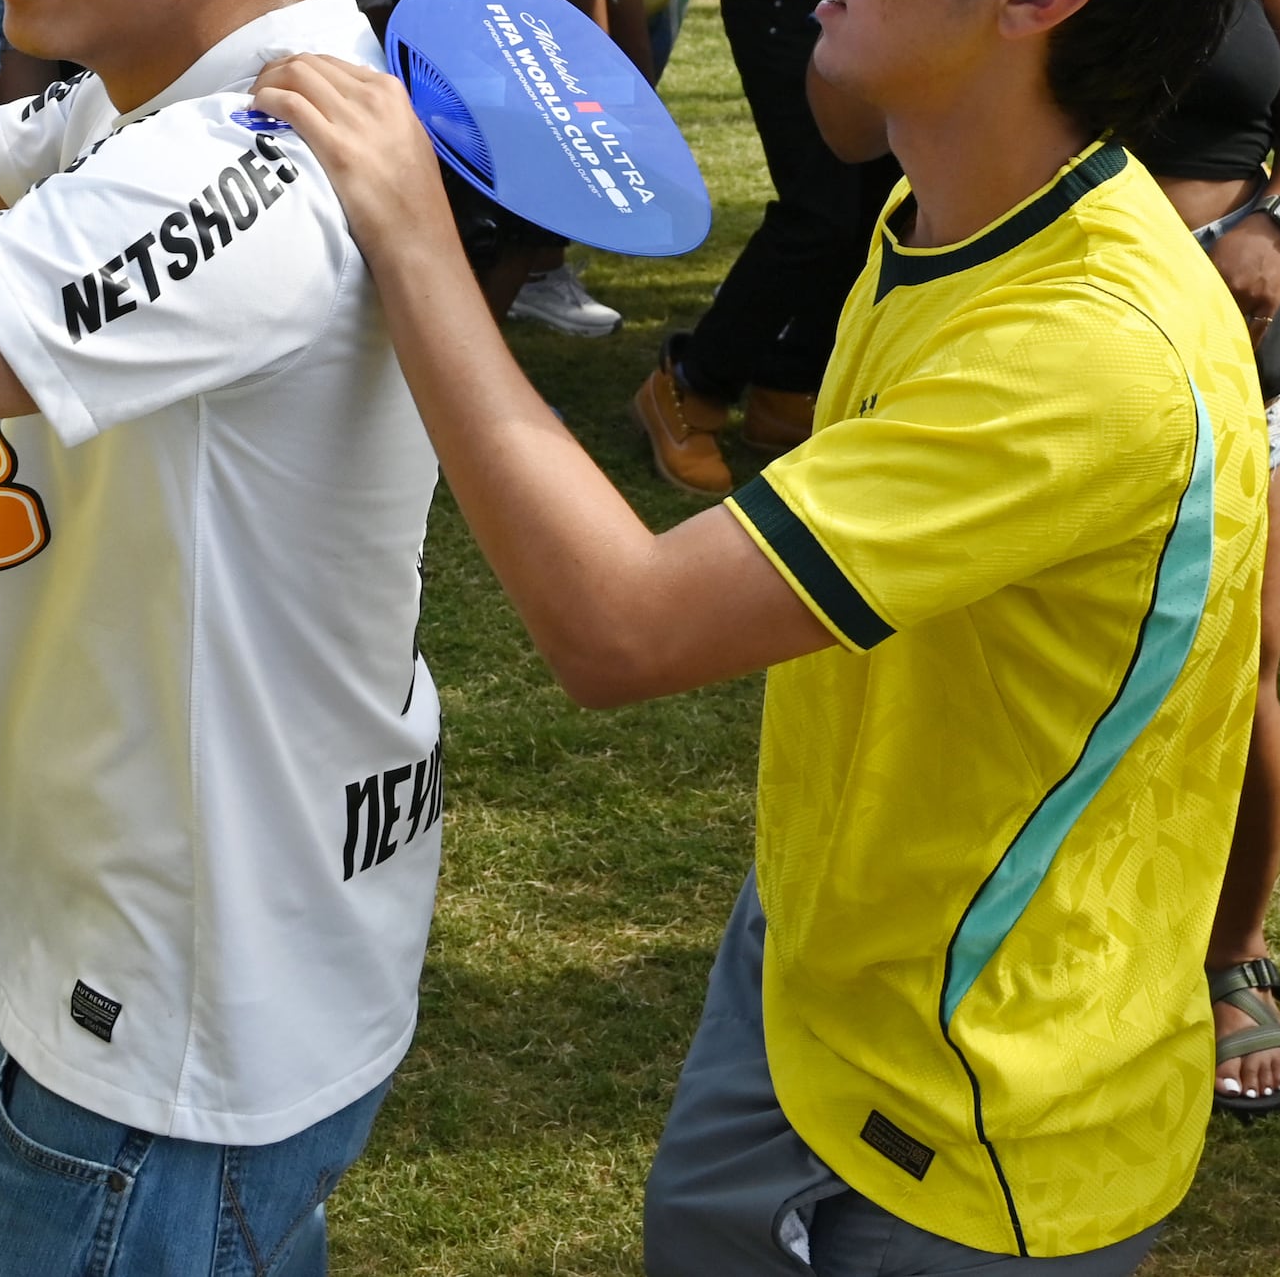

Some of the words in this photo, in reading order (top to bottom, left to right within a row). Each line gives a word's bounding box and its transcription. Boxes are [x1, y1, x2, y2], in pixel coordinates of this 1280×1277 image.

[482, 19, 505, 49] OFFICIAL
[501, 49, 518, 67] BEER
[512, 67, 538, 101] SPONSOR
[534, 101, 546, 112] OF
[540, 112, 555, 126] THE
[549, 126, 564, 142] FIFA
[560, 141, 582, 168] WORLD
[577, 168, 592, 184] CUP
[485, 4, 524, 47] FIFA
[515, 48, 571, 122] WORLD
[563, 124, 601, 166] CUP
[519, 11, 588, 95] Michelob
[591, 120, 656, 204] ULTRA
[61, 132, 299, 345] NETSHOES
[76, 984, 118, 1014] AUTHENTIC
